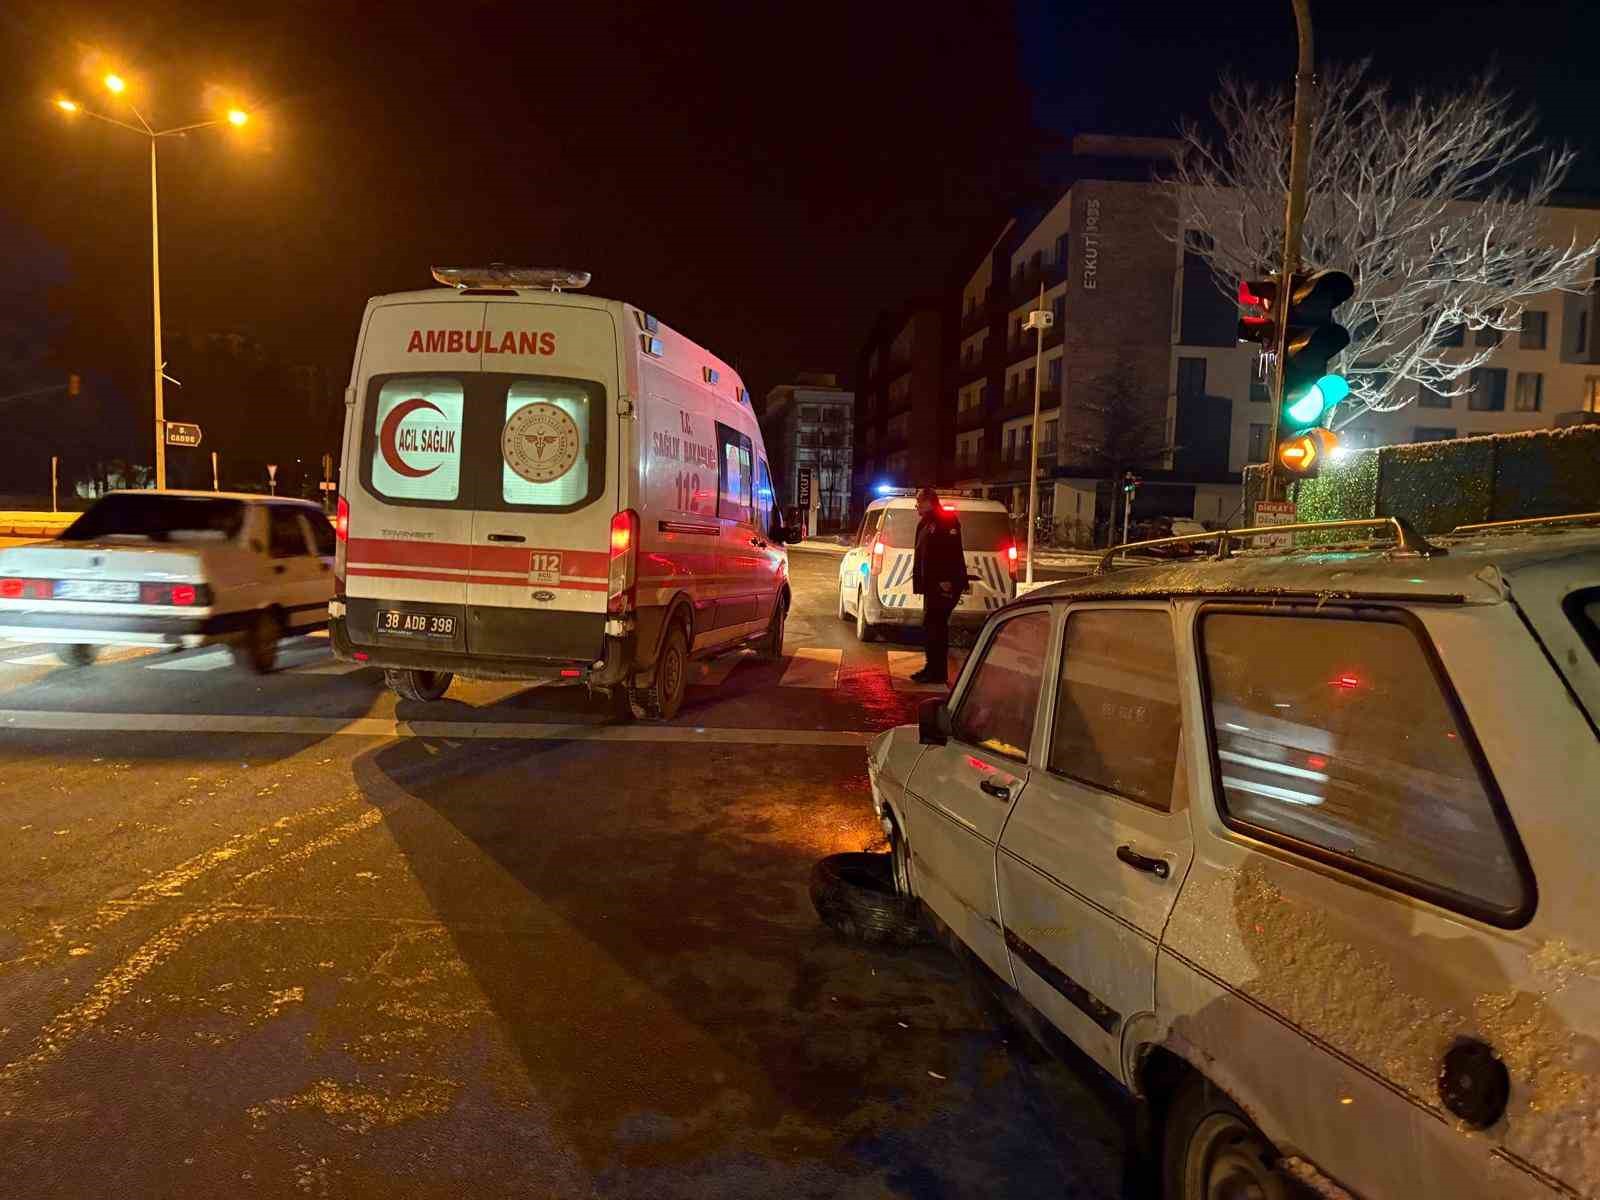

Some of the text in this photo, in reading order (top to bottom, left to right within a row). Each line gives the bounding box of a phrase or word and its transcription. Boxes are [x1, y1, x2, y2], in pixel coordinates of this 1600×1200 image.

[1083, 236, 1098, 289] ERKUT
[407, 329, 556, 356] AMBULANS
[420, 425, 456, 454] SAĞLIK
[675, 471, 701, 512] 112
[532, 553, 560, 571] 112
[385, 613, 400, 628] 38
[404, 615, 426, 631] ADB
[430, 617, 453, 633] 398
